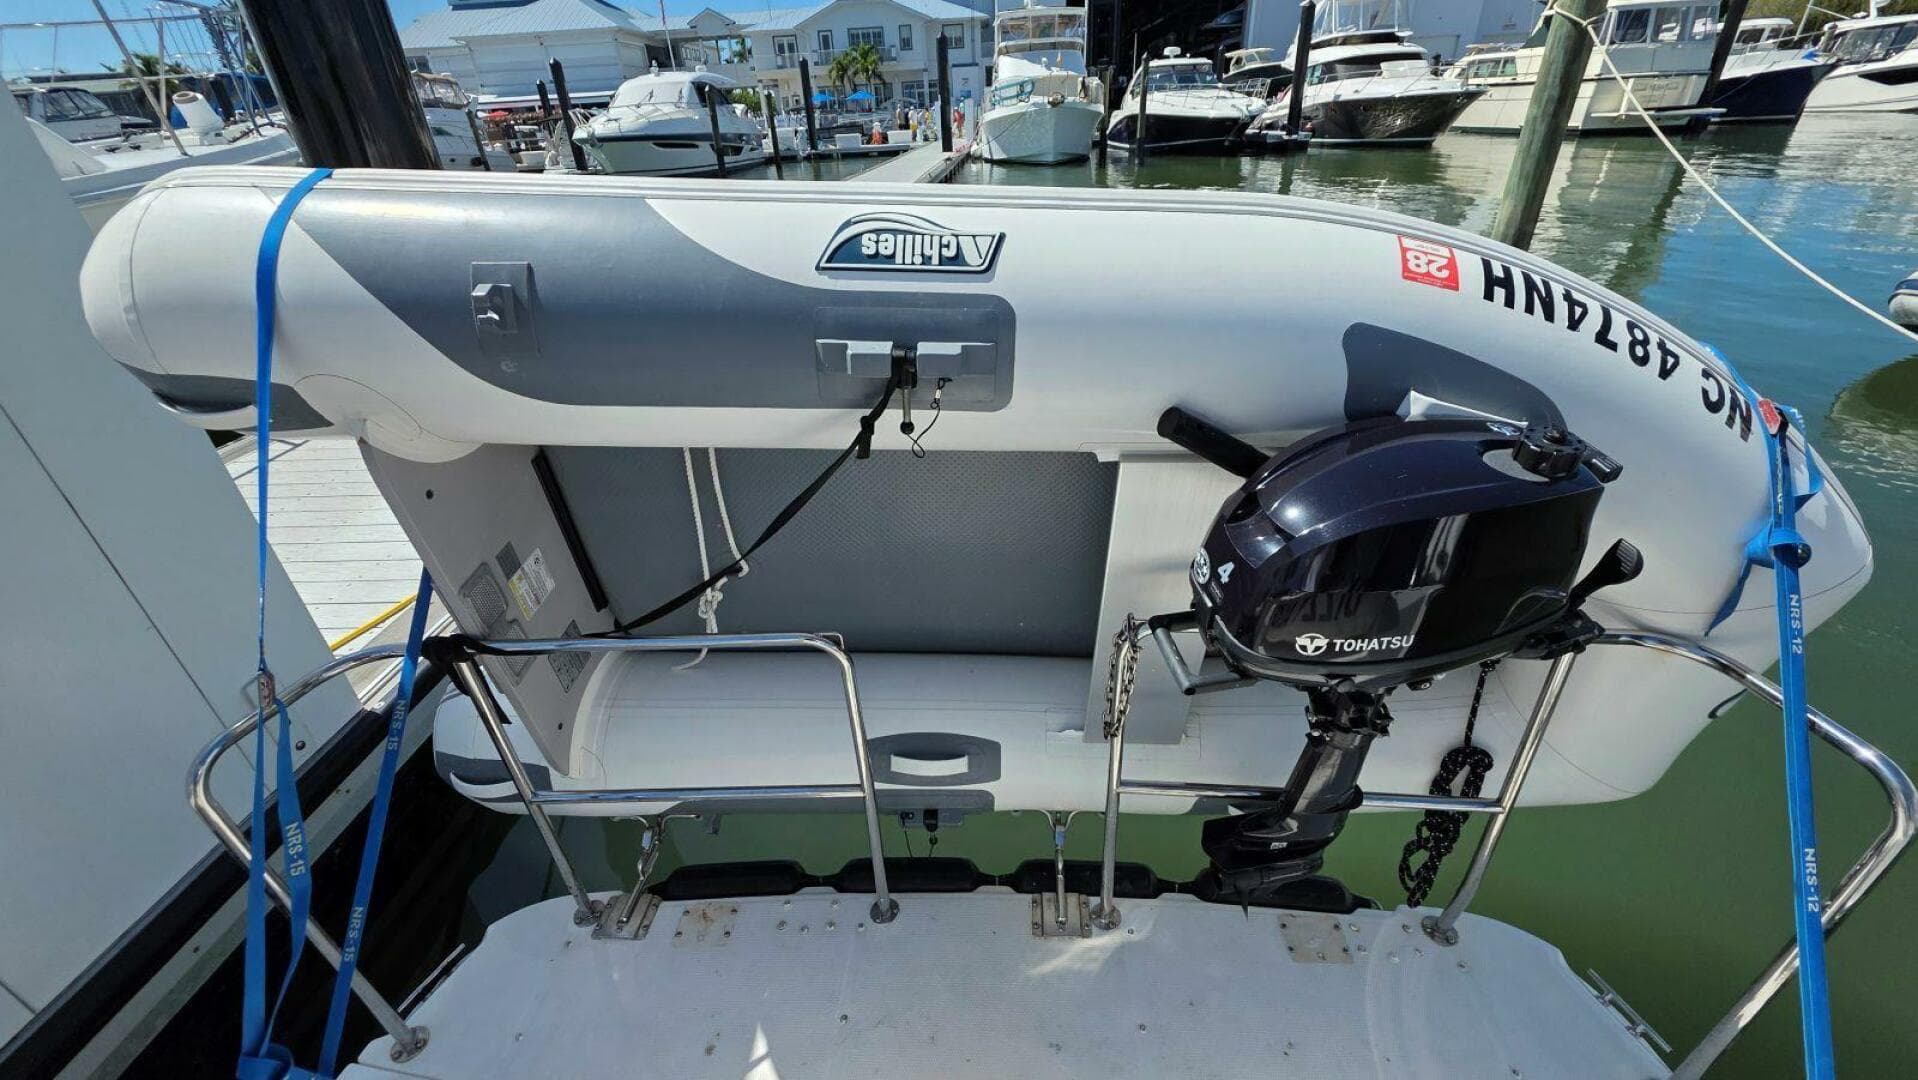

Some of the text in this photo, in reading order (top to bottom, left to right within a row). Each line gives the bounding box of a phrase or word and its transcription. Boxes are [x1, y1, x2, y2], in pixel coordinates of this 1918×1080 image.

[861, 232, 993, 266] Achilles
[1406, 250, 1450, 279] 28
[1481, 257, 1753, 443] NC 4874NH
[1217, 561, 1235, 584] 4
[1332, 634, 1416, 653] TOHATSU
[1789, 595, 1803, 654] NRS-12
[388, 701, 405, 751] NRS-15
[285, 823, 306, 877] NRS-15
[1805, 848, 1819, 912] NRS-12
[343, 906, 363, 962] NRS-15
